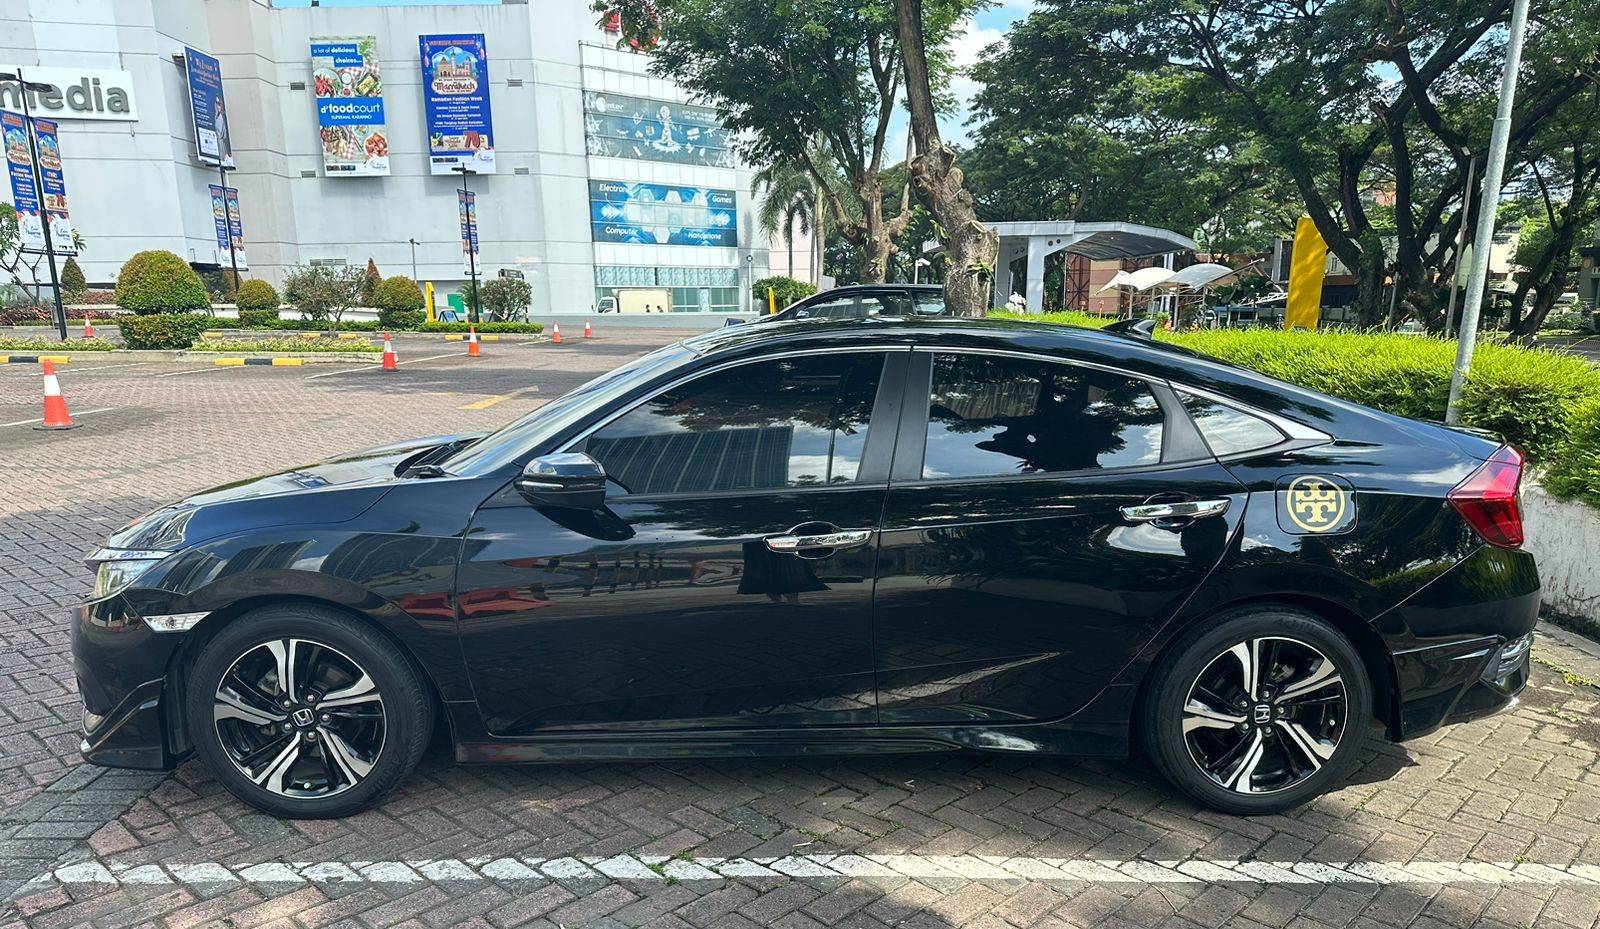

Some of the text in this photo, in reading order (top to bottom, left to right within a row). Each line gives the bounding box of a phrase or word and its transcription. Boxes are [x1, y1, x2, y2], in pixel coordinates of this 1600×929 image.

[0, 77, 130, 113] media
[712, 195, 732, 204] Games
[605, 226, 638, 236] Computer
[687, 231, 722, 240] Handphone
